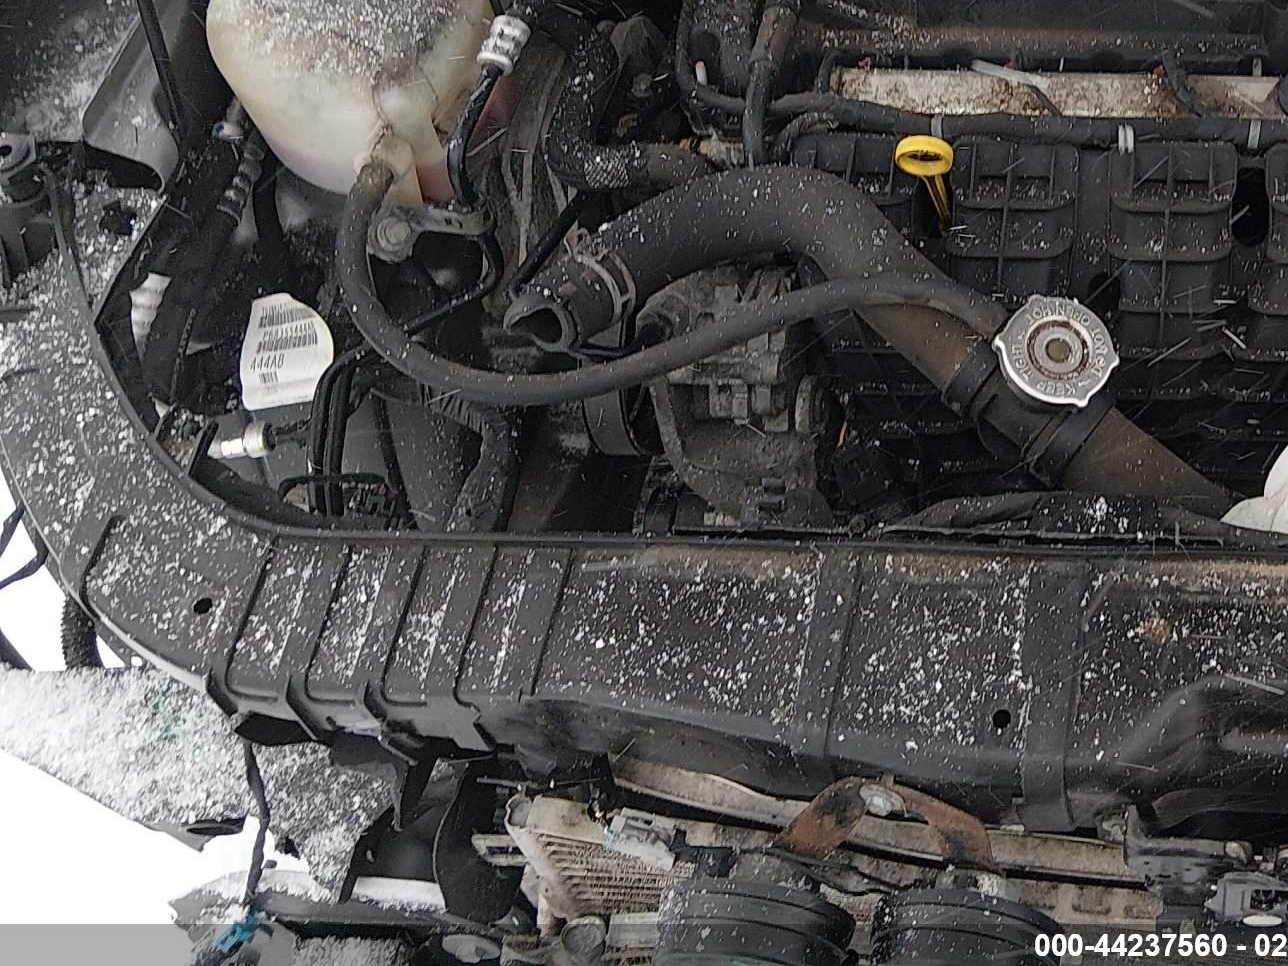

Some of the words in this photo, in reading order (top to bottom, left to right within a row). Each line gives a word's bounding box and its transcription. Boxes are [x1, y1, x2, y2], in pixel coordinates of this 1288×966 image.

[1026, 305, 1052, 325] HOT
[1090, 327, 1108, 354] NOT
[1011, 345, 1033, 381] TIGHT
[1036, 382, 1076, 395] KEEP
